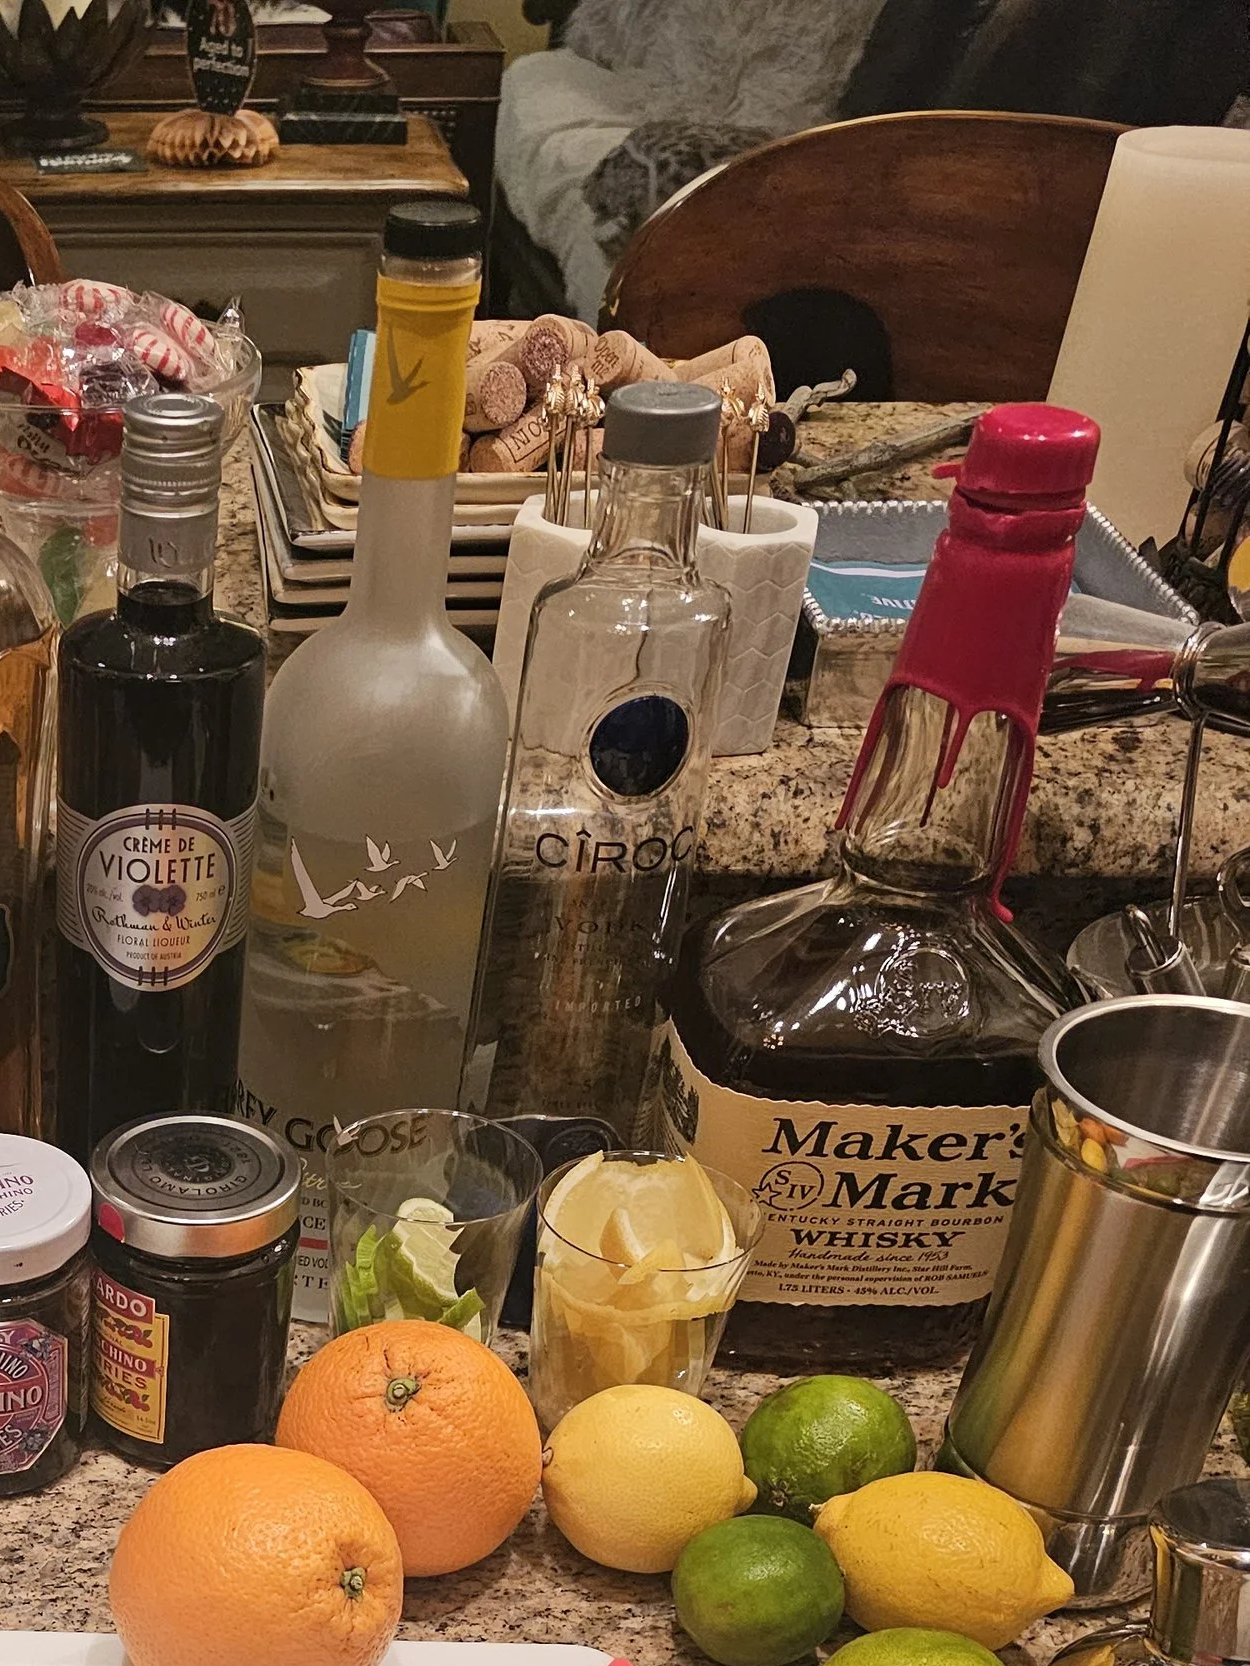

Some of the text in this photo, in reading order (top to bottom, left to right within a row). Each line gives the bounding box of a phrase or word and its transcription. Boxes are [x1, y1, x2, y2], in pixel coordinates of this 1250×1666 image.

[231, 43, 244, 58] to
[178, 836, 196, 853] DE
[99, 851, 216, 885] VIOLETTE
[162, 915, 172, 932] &
[175, 912, 217, 931] Winter
[117, 934, 190, 948] FLORAL LIQUEUR
[236, 1077, 429, 1160] REY GOOSE
[149, 1174, 247, 1196] GIROLAMO
[821, 1170, 1018, 1212] Mark
[767, 1213, 1004, 1228] ENTUCKY STRAIGHT BOURBON
[789, 1228, 966, 1249] WHISKY
[788, 1248, 949, 1263] Handmade since 1953
[753, 1259, 778, 1268] Made
[778, 1261, 790, 1270] by
[790, 1262, 825, 1271] Maker's
[826, 1263, 849, 1272] Mark
[851, 1265, 891, 1274] Distillery
[912, 1264, 931, 1272] Star
[931, 1263, 949, 1272] Hill
[784, 1271, 810, 1280] under
[811, 1272, 826, 1281] the
[826, 1273, 863, 1284] personal
[864, 1274, 912, 1284] supervision
[913, 1274, 924, 1282] of
[924, 1274, 945, 1283] ROB
[95, 1275, 147, 1318] ARDO
[801, 1284, 845, 1294] LITERS
[853, 1286, 878, 1296] 45%
[100, 1338, 147, 1373] CHINO
[103, 1359, 147, 1390] RIES
